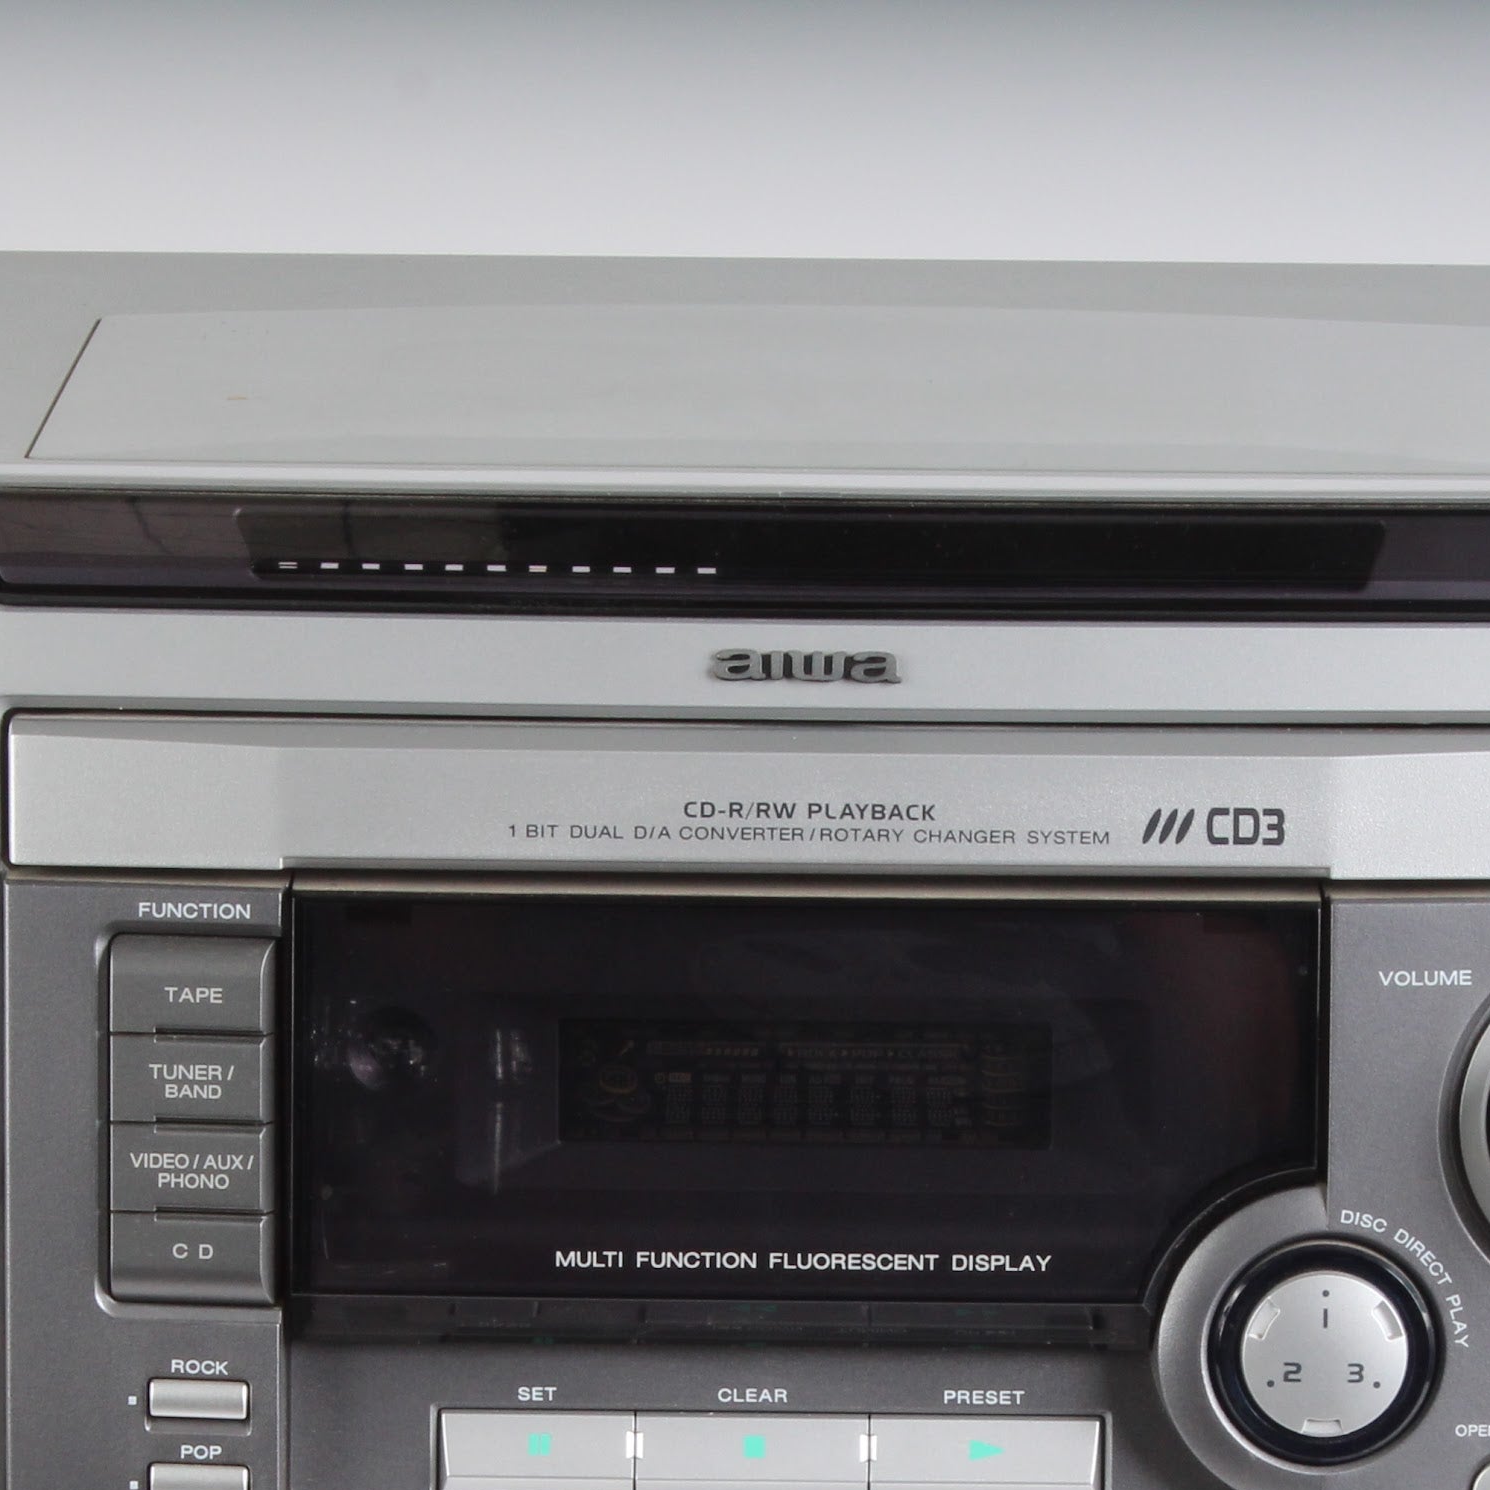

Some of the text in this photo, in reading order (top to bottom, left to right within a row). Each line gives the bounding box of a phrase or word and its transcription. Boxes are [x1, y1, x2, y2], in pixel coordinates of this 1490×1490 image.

[711, 648, 901, 684] aiwa
[683, 801, 936, 821] CD-R/RW PLAYBACK
[508, 824, 516, 838] 1
[525, 823, 559, 839] BIT
[569, 824, 624, 840] DUAL
[633, 825, 672, 840] D/A
[913, 828, 1016, 844] CHANGER
[1026, 829, 1110, 845] SYSTEM
[1206, 807, 1286, 846] CD3
[138, 901, 251, 920] FUNCTION
[1378, 969, 1473, 987] VOLUME
[163, 986, 223, 1004] TAPE
[164, 1084, 223, 1099] BAND
[158, 1174, 230, 1190] PHONO
[555, 1250, 1052, 1272] MULTI FUNCTION FLUORESCENT DISPLAY
[1340, 1209, 1470, 1348] DISC DIRECT PLAY
[170, 1358, 229, 1376] ROCK
[1282, 1361, 1302, 1383] 2
[1346, 1362, 1365, 1384] 3
[517, 1386, 558, 1402] SET
[717, 1387, 788, 1403] CLEAR
[943, 1389, 1026, 1405] PRESET
[180, 1444, 223, 1460] POP
